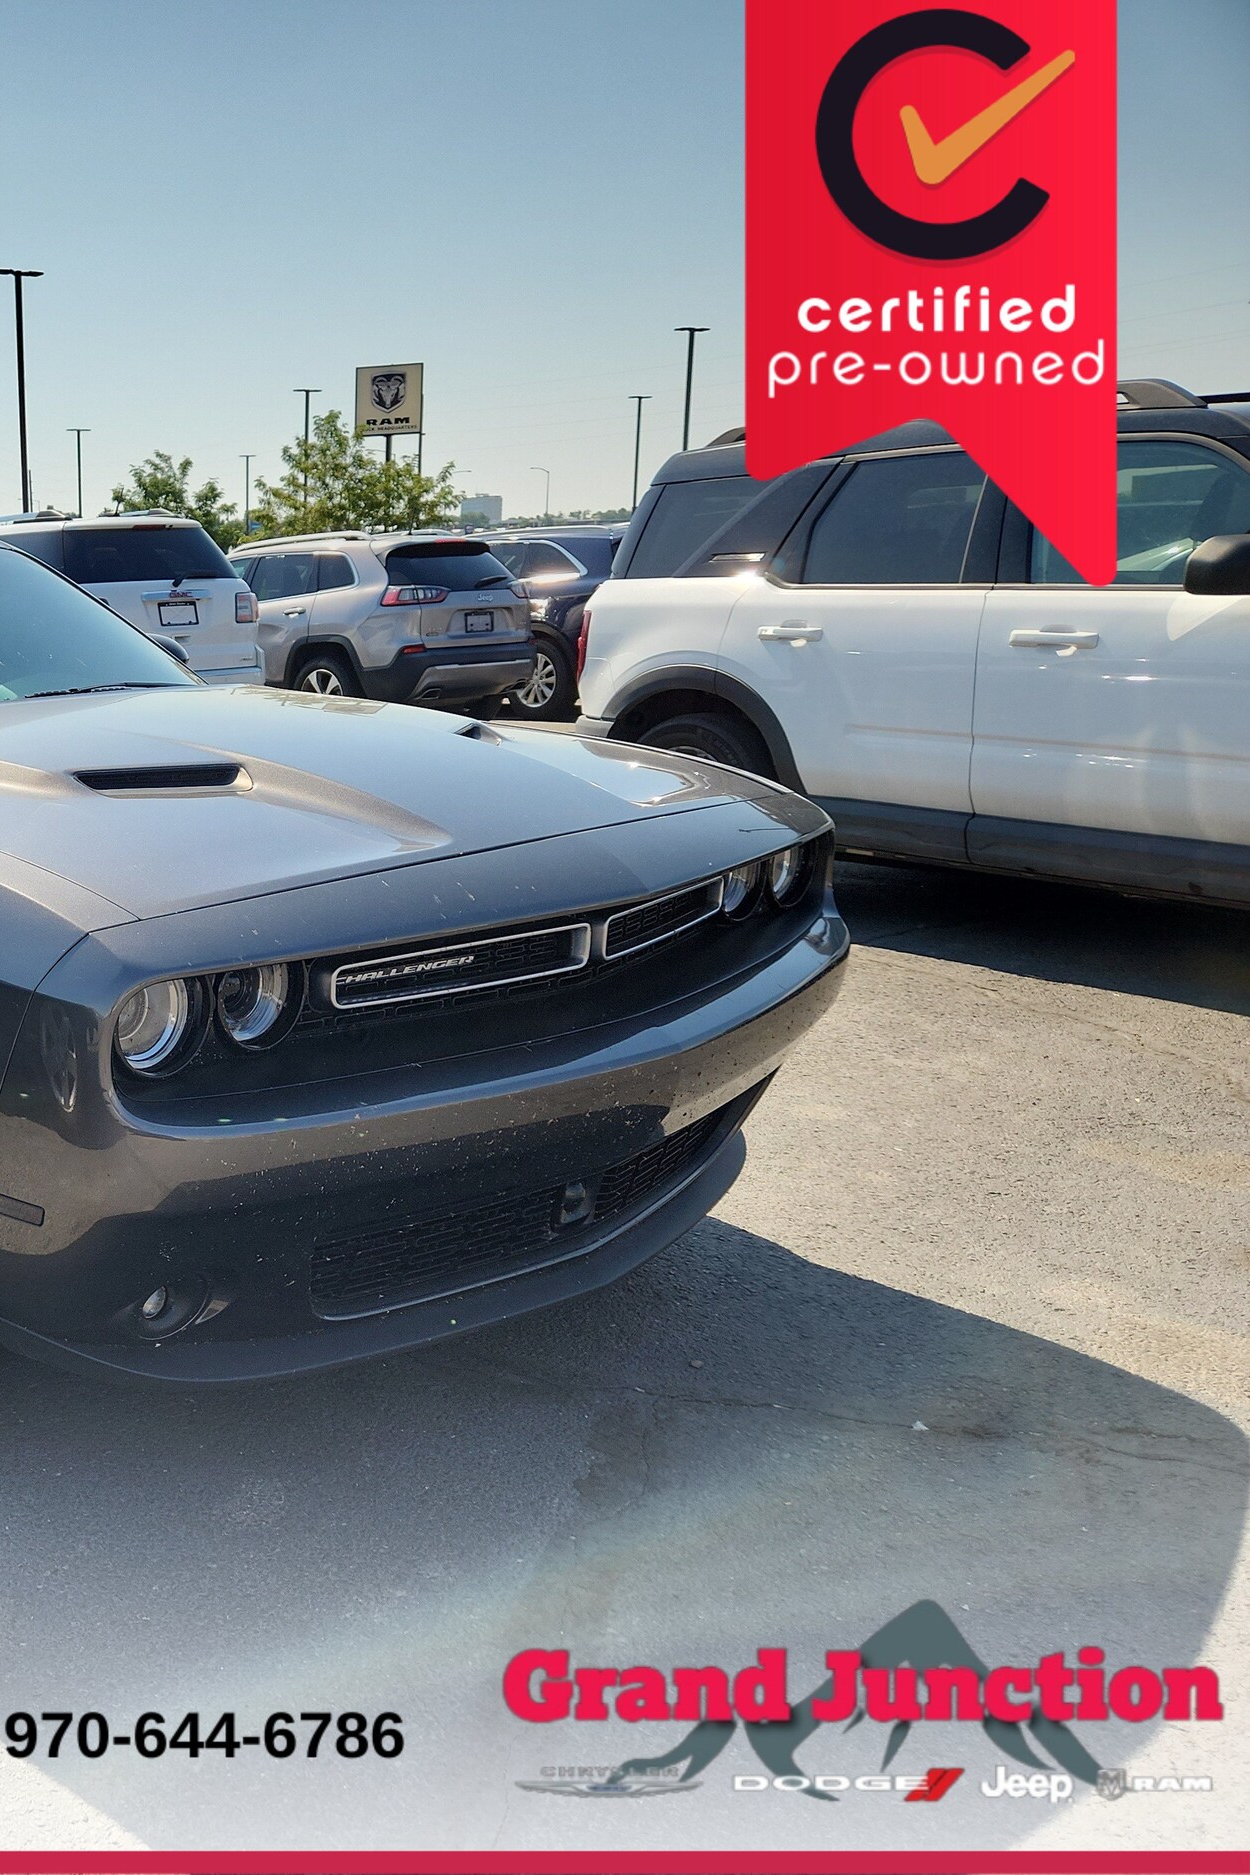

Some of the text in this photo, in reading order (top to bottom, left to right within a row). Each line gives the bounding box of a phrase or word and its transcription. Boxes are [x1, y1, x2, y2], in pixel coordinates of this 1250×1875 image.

[366, 417, 410, 425] RAM
[478, 594, 494, 602] Jeep
[335, 955, 475, 985] CHALLENGER
